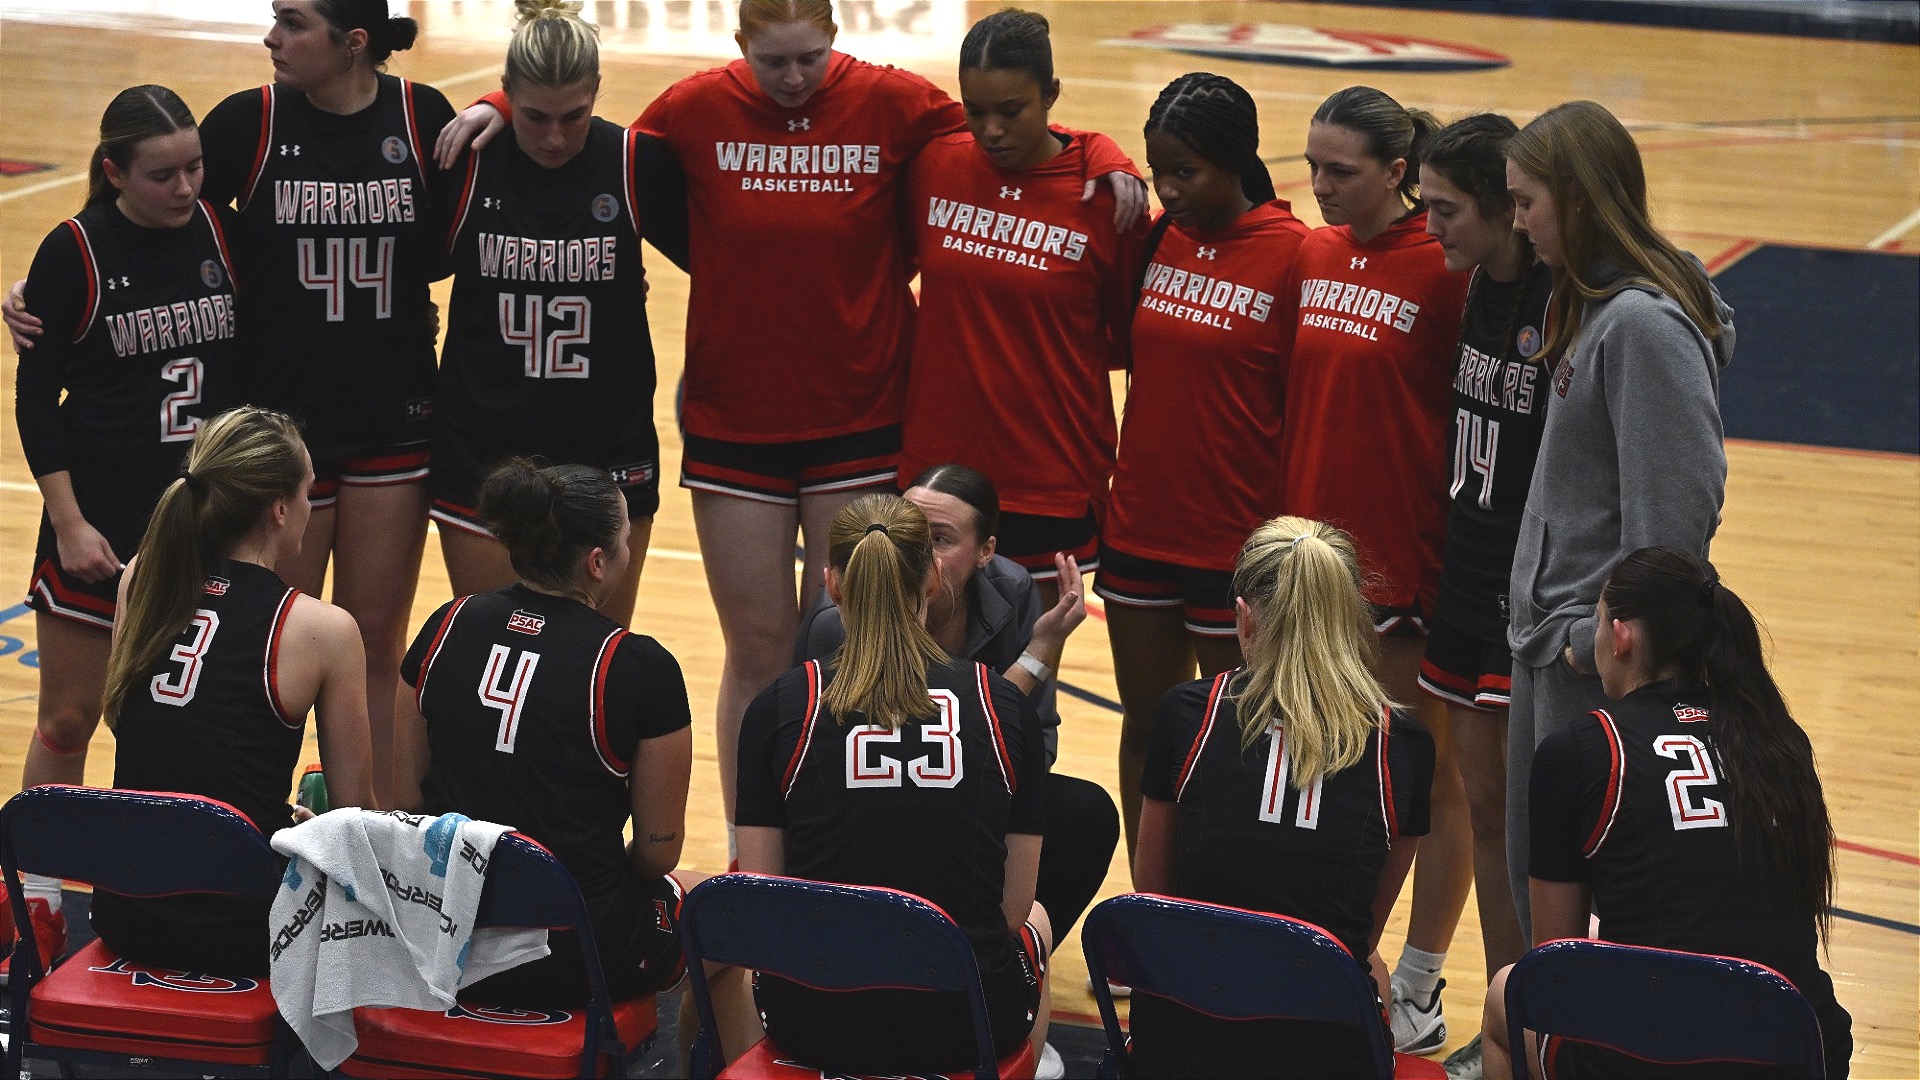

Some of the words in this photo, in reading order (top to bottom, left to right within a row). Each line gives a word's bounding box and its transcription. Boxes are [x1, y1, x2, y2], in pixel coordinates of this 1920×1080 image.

[716, 142, 880, 174] WARRIORS
[741, 177, 854, 192] BASKETBALL
[275, 178, 415, 225] WARRIORS
[927, 197, 1089, 262] WARRIORS
[297, 236, 395, 321] 44
[479, 232, 616, 282] WARRIORS
[943, 235, 1049, 271] BASKETBALL
[1142, 296, 1232, 330] BASKETBALL
[1143, 262, 1275, 323] WARRIORS
[1300, 279, 1420, 333] WARRIORS
[105, 294, 235, 358] WARRIORS
[499, 292, 591, 378] 42
[1302, 313, 1378, 341] BASKETBALL
[160, 357, 204, 443] 2
[1450, 408, 1500, 510] 14
[203, 580, 229, 591] SAC
[510, 614, 543, 630] PSAC
[150, 608, 220, 707] 3
[478, 643, 540, 754] 4
[1652, 734, 1732, 831] 2
